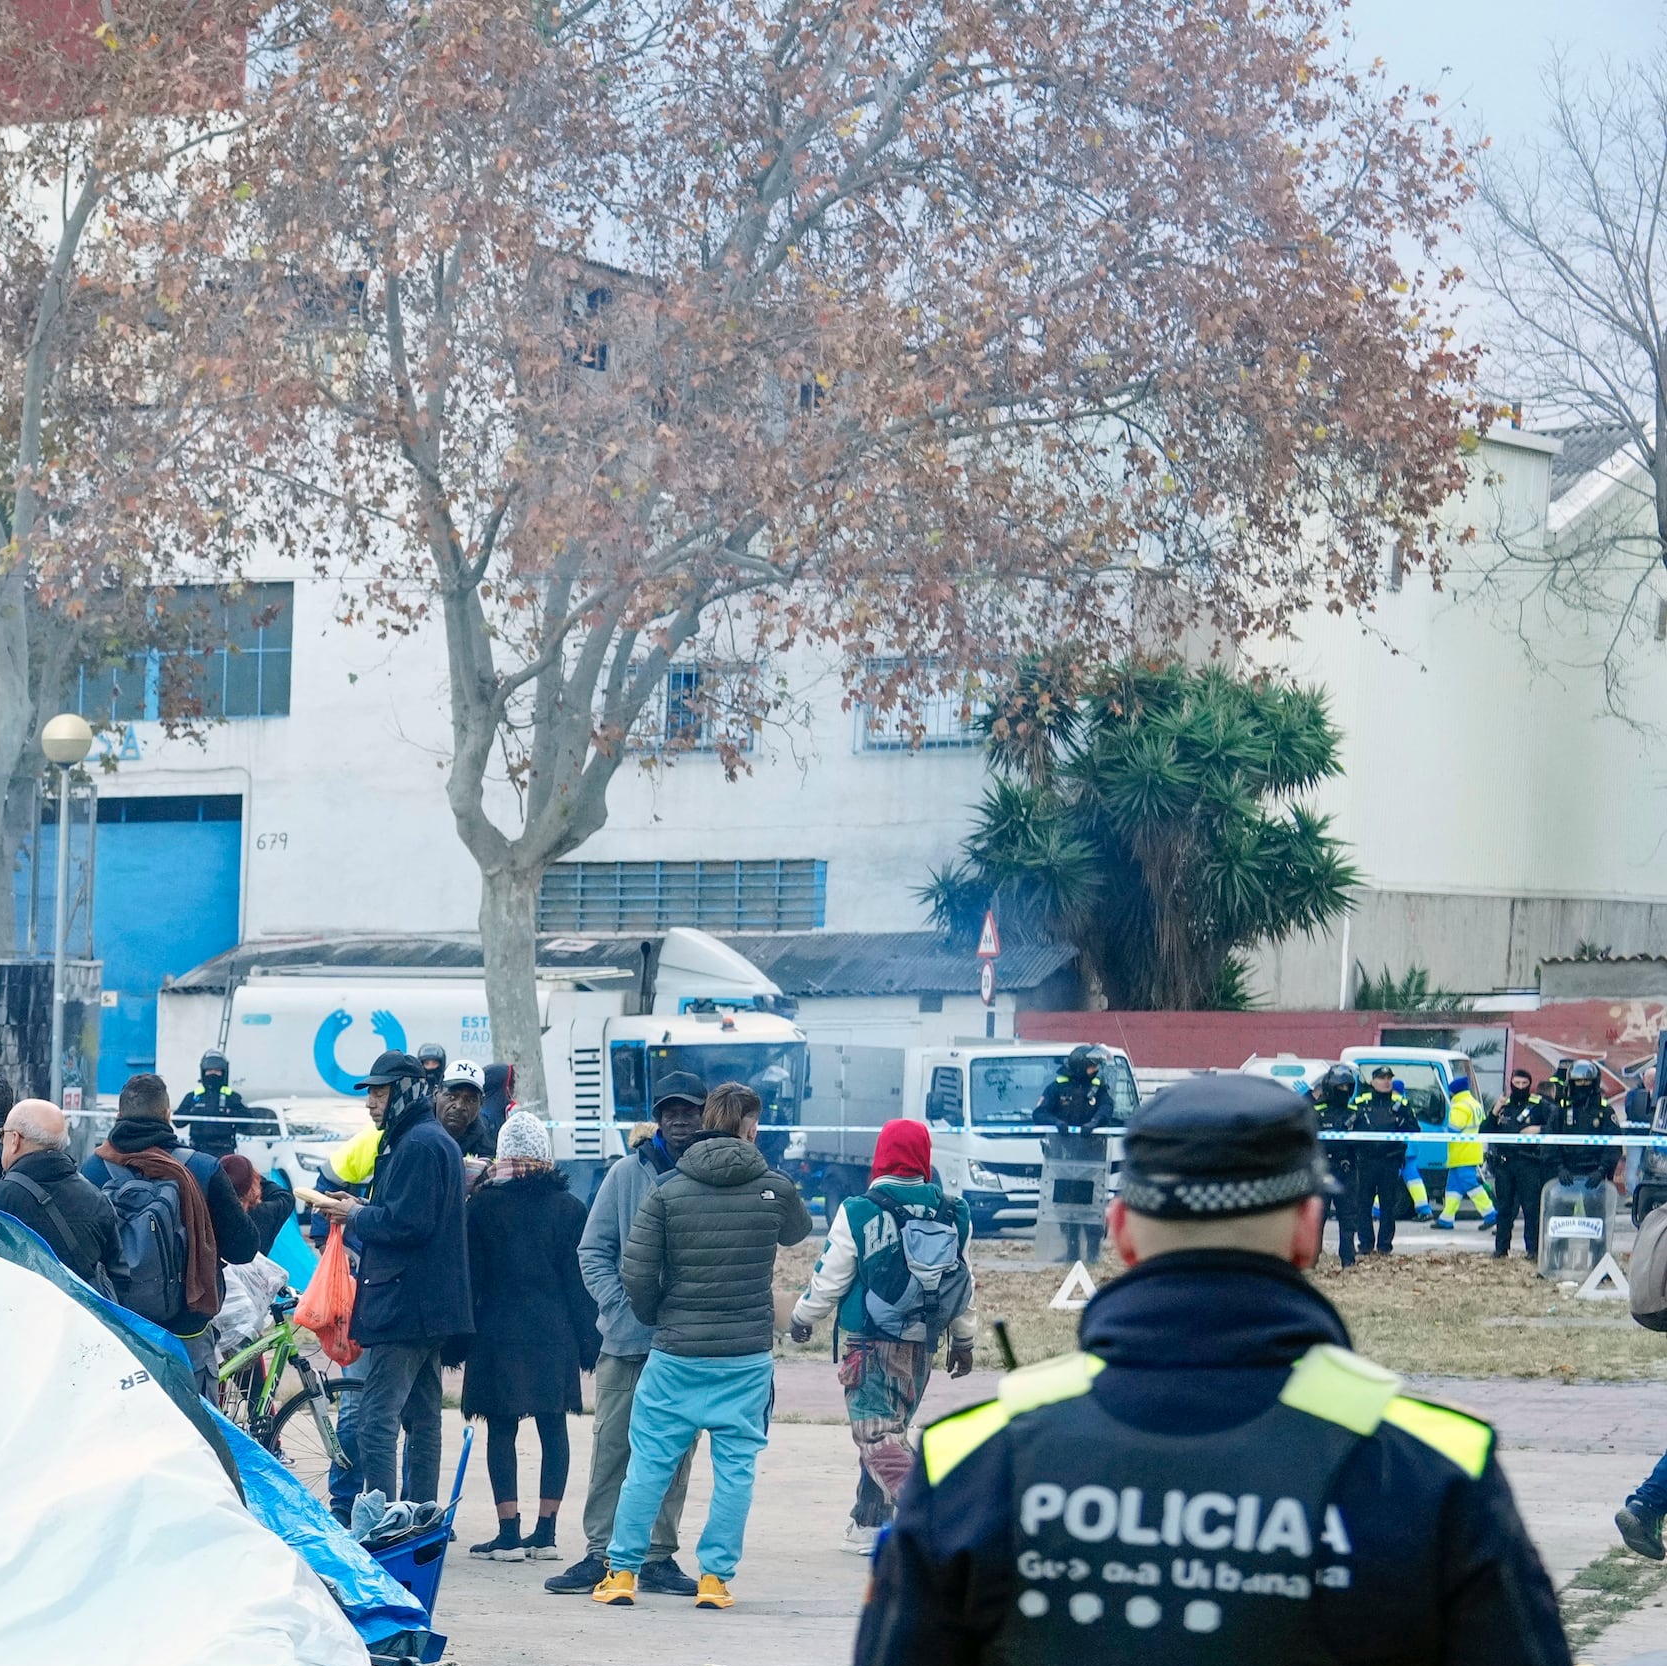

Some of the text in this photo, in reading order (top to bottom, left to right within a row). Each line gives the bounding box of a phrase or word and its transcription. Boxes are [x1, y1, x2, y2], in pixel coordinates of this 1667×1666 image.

[257, 832, 288, 850] 679
[457, 1063, 477, 1077] NY
[1020, 1482, 1312, 1557] POLICIA
